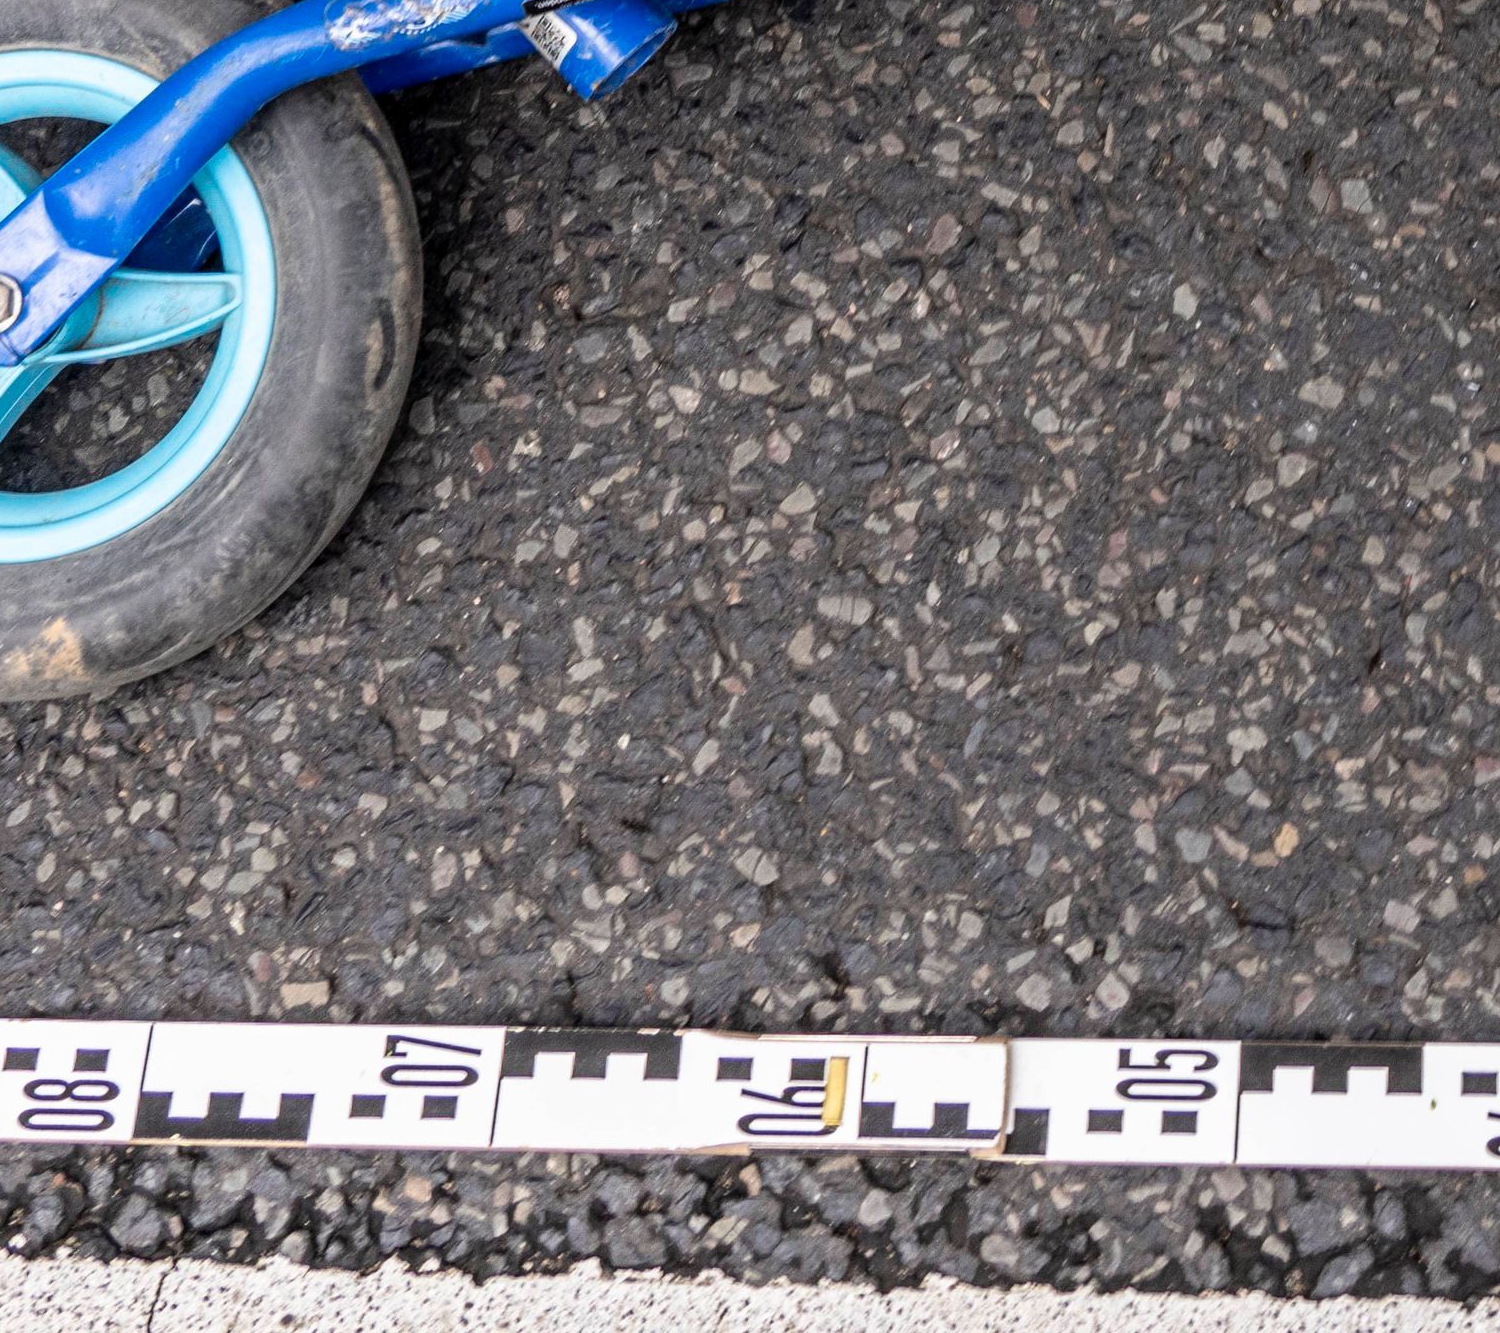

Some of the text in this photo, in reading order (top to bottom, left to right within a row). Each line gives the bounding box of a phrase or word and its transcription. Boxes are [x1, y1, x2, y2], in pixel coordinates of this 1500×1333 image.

[381, 1034, 482, 1088] 07
[1116, 1048, 1220, 1102] 05
[17, 1079, 120, 1131] 08
[737, 1085, 841, 1136] 06
